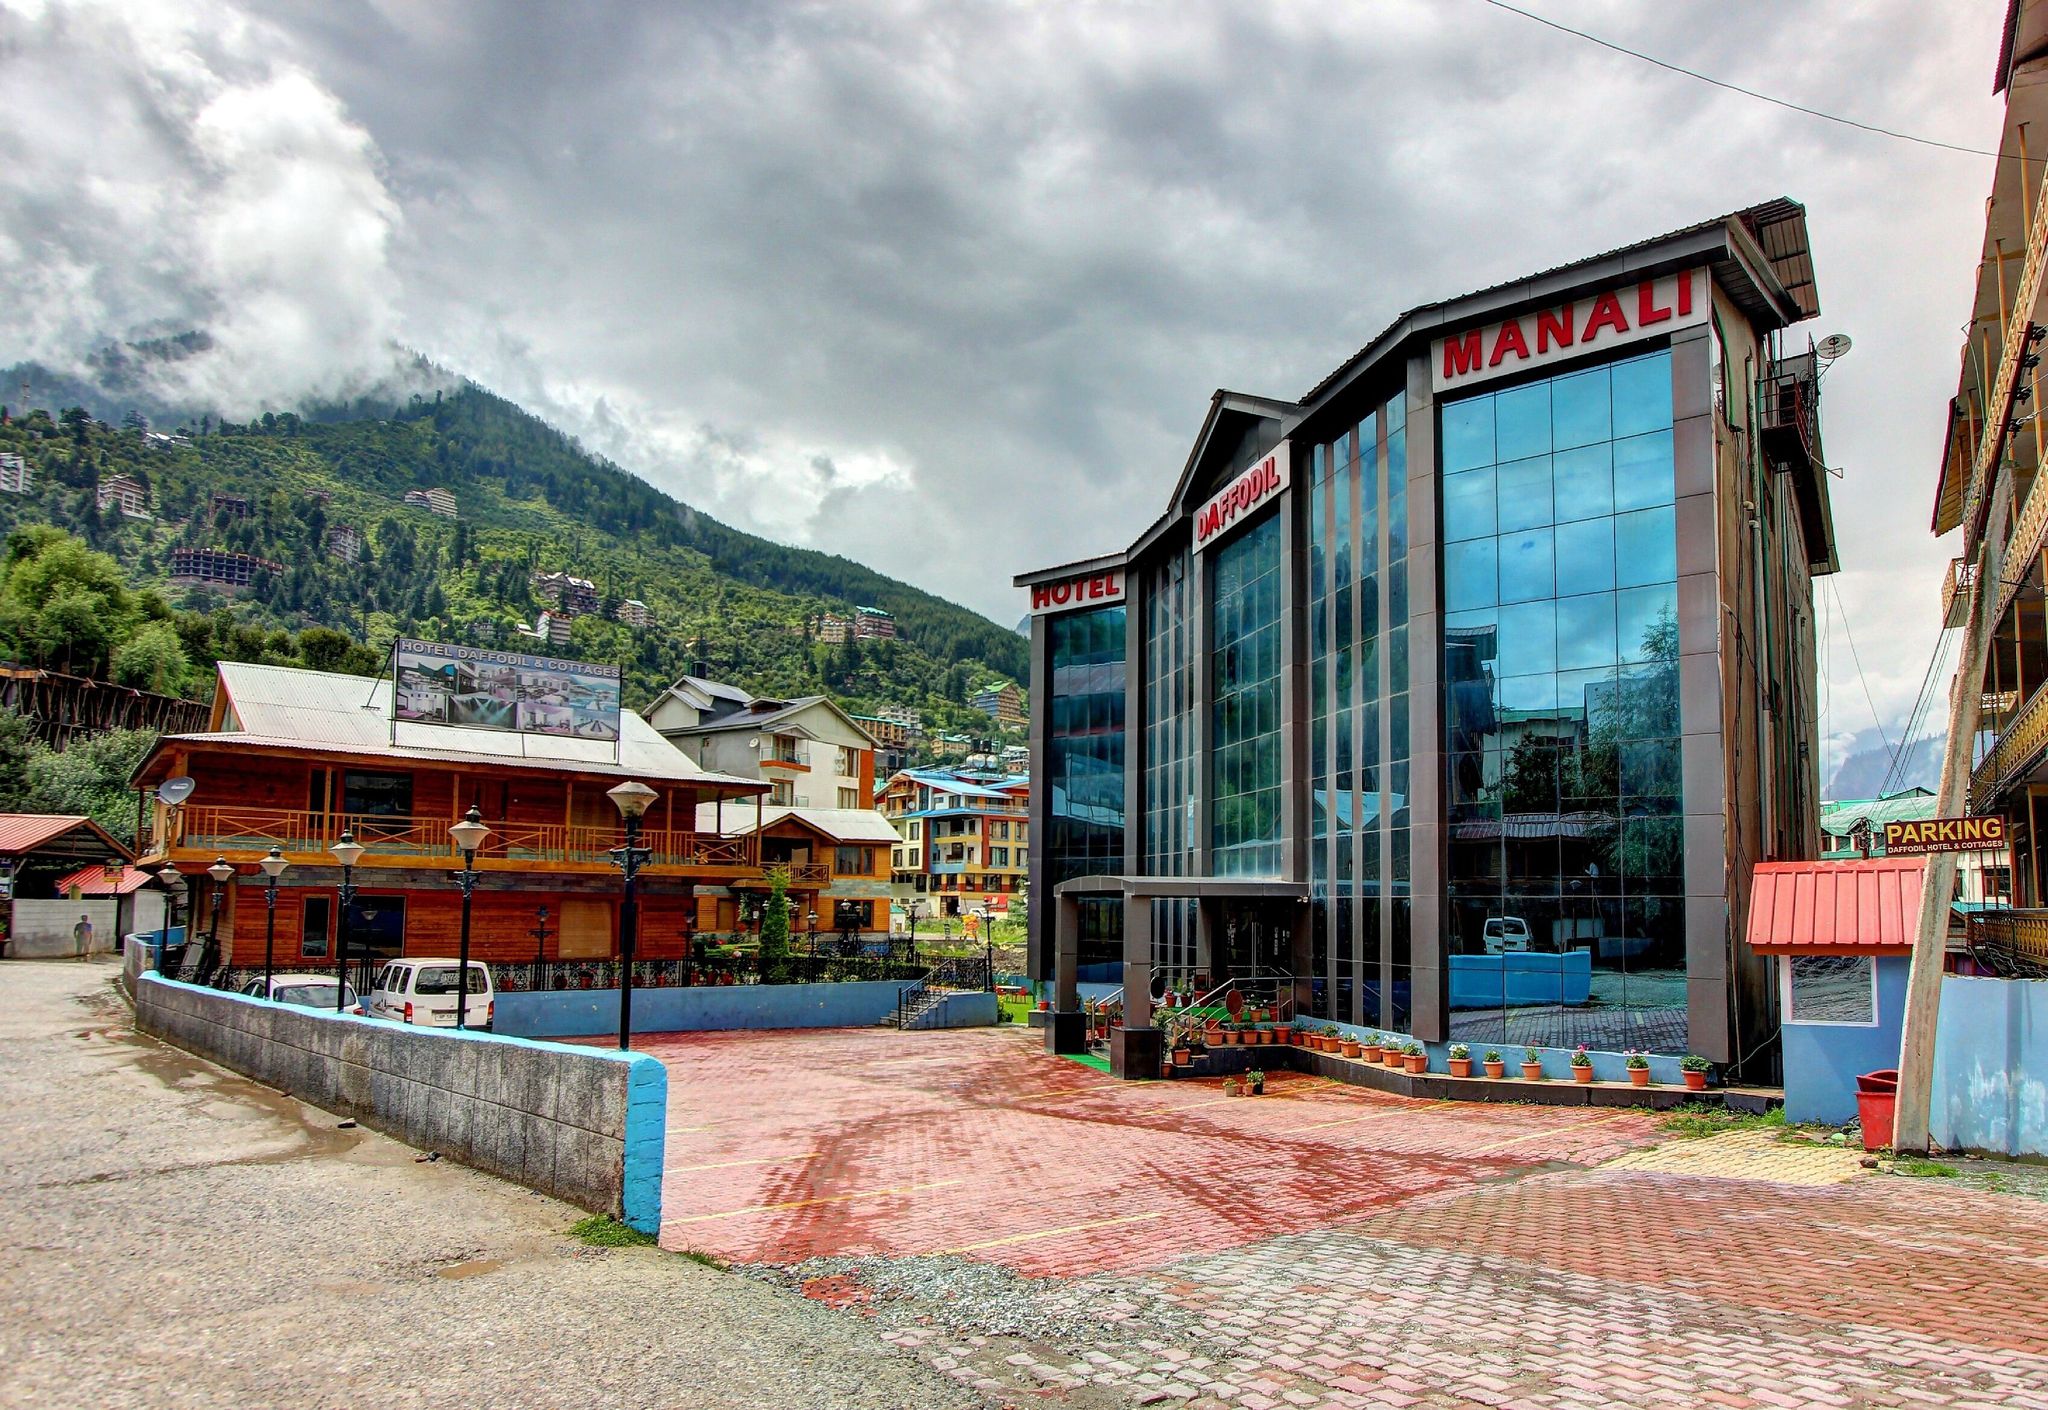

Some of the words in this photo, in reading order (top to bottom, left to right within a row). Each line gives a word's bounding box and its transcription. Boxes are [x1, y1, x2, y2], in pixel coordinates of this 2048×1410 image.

[1443, 270, 1693, 379] MANALI
[1197, 456, 1281, 542] DAFFODIL
[1032, 571, 1120, 610] HOTEL
[401, 641, 453, 658] HOTEL
[458, 648, 530, 667] DAFFODIL
[534, 658, 544, 669] &
[548, 660, 620, 678] COTTAGES
[1887, 818, 2001, 844] PARKING
[1888, 844, 1926, 854] DAFFODIL
[1927, 843, 1953, 851] HOTEL
[1954, 842, 1960, 850] &
[1961, 840, 2003, 850] COTTAGES
